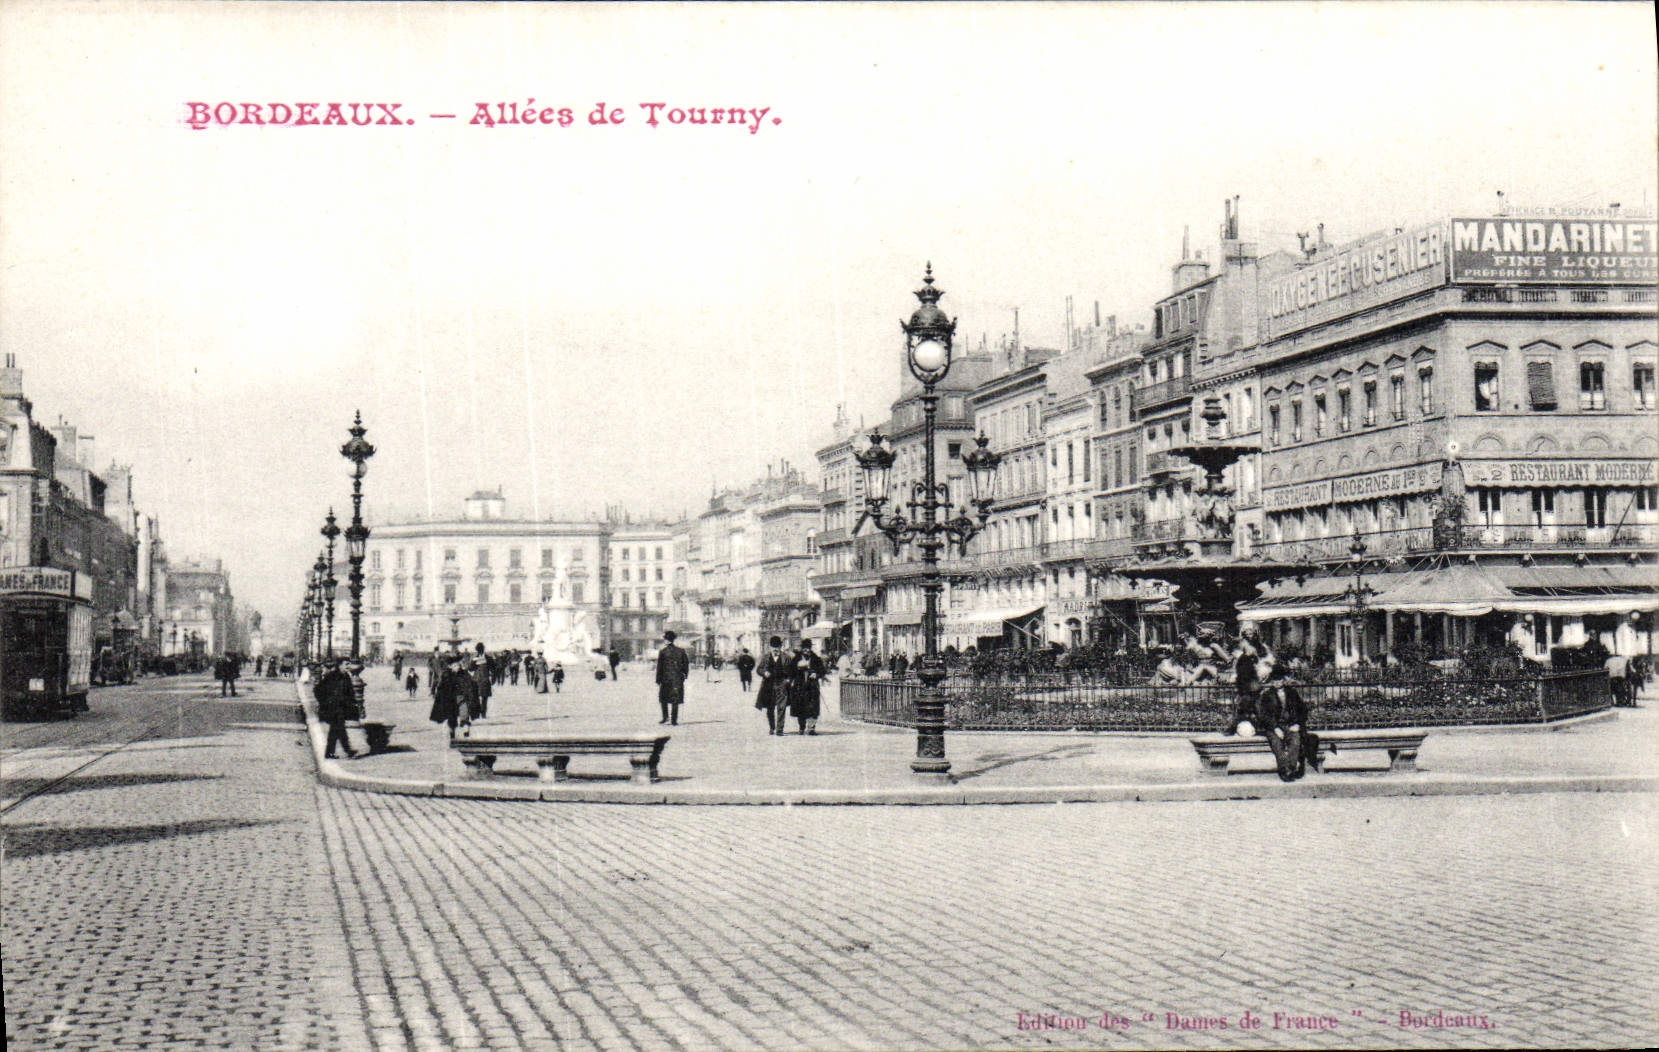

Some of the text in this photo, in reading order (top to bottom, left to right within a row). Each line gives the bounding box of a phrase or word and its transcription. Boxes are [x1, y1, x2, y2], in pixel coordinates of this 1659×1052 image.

[1351, 224, 1443, 293] CUSENIER
[1493, 256, 1547, 268] FINE
[1554, 268, 1586, 278] TOUS
[1509, 462, 1591, 482] RESTAURANT
[1594, 463, 1654, 482] MODERNE
[1273, 483, 1328, 507] RESTAURANT
[1335, 473, 1390, 498] MODERNE
[33, 574, 70, 590] FRANCE
